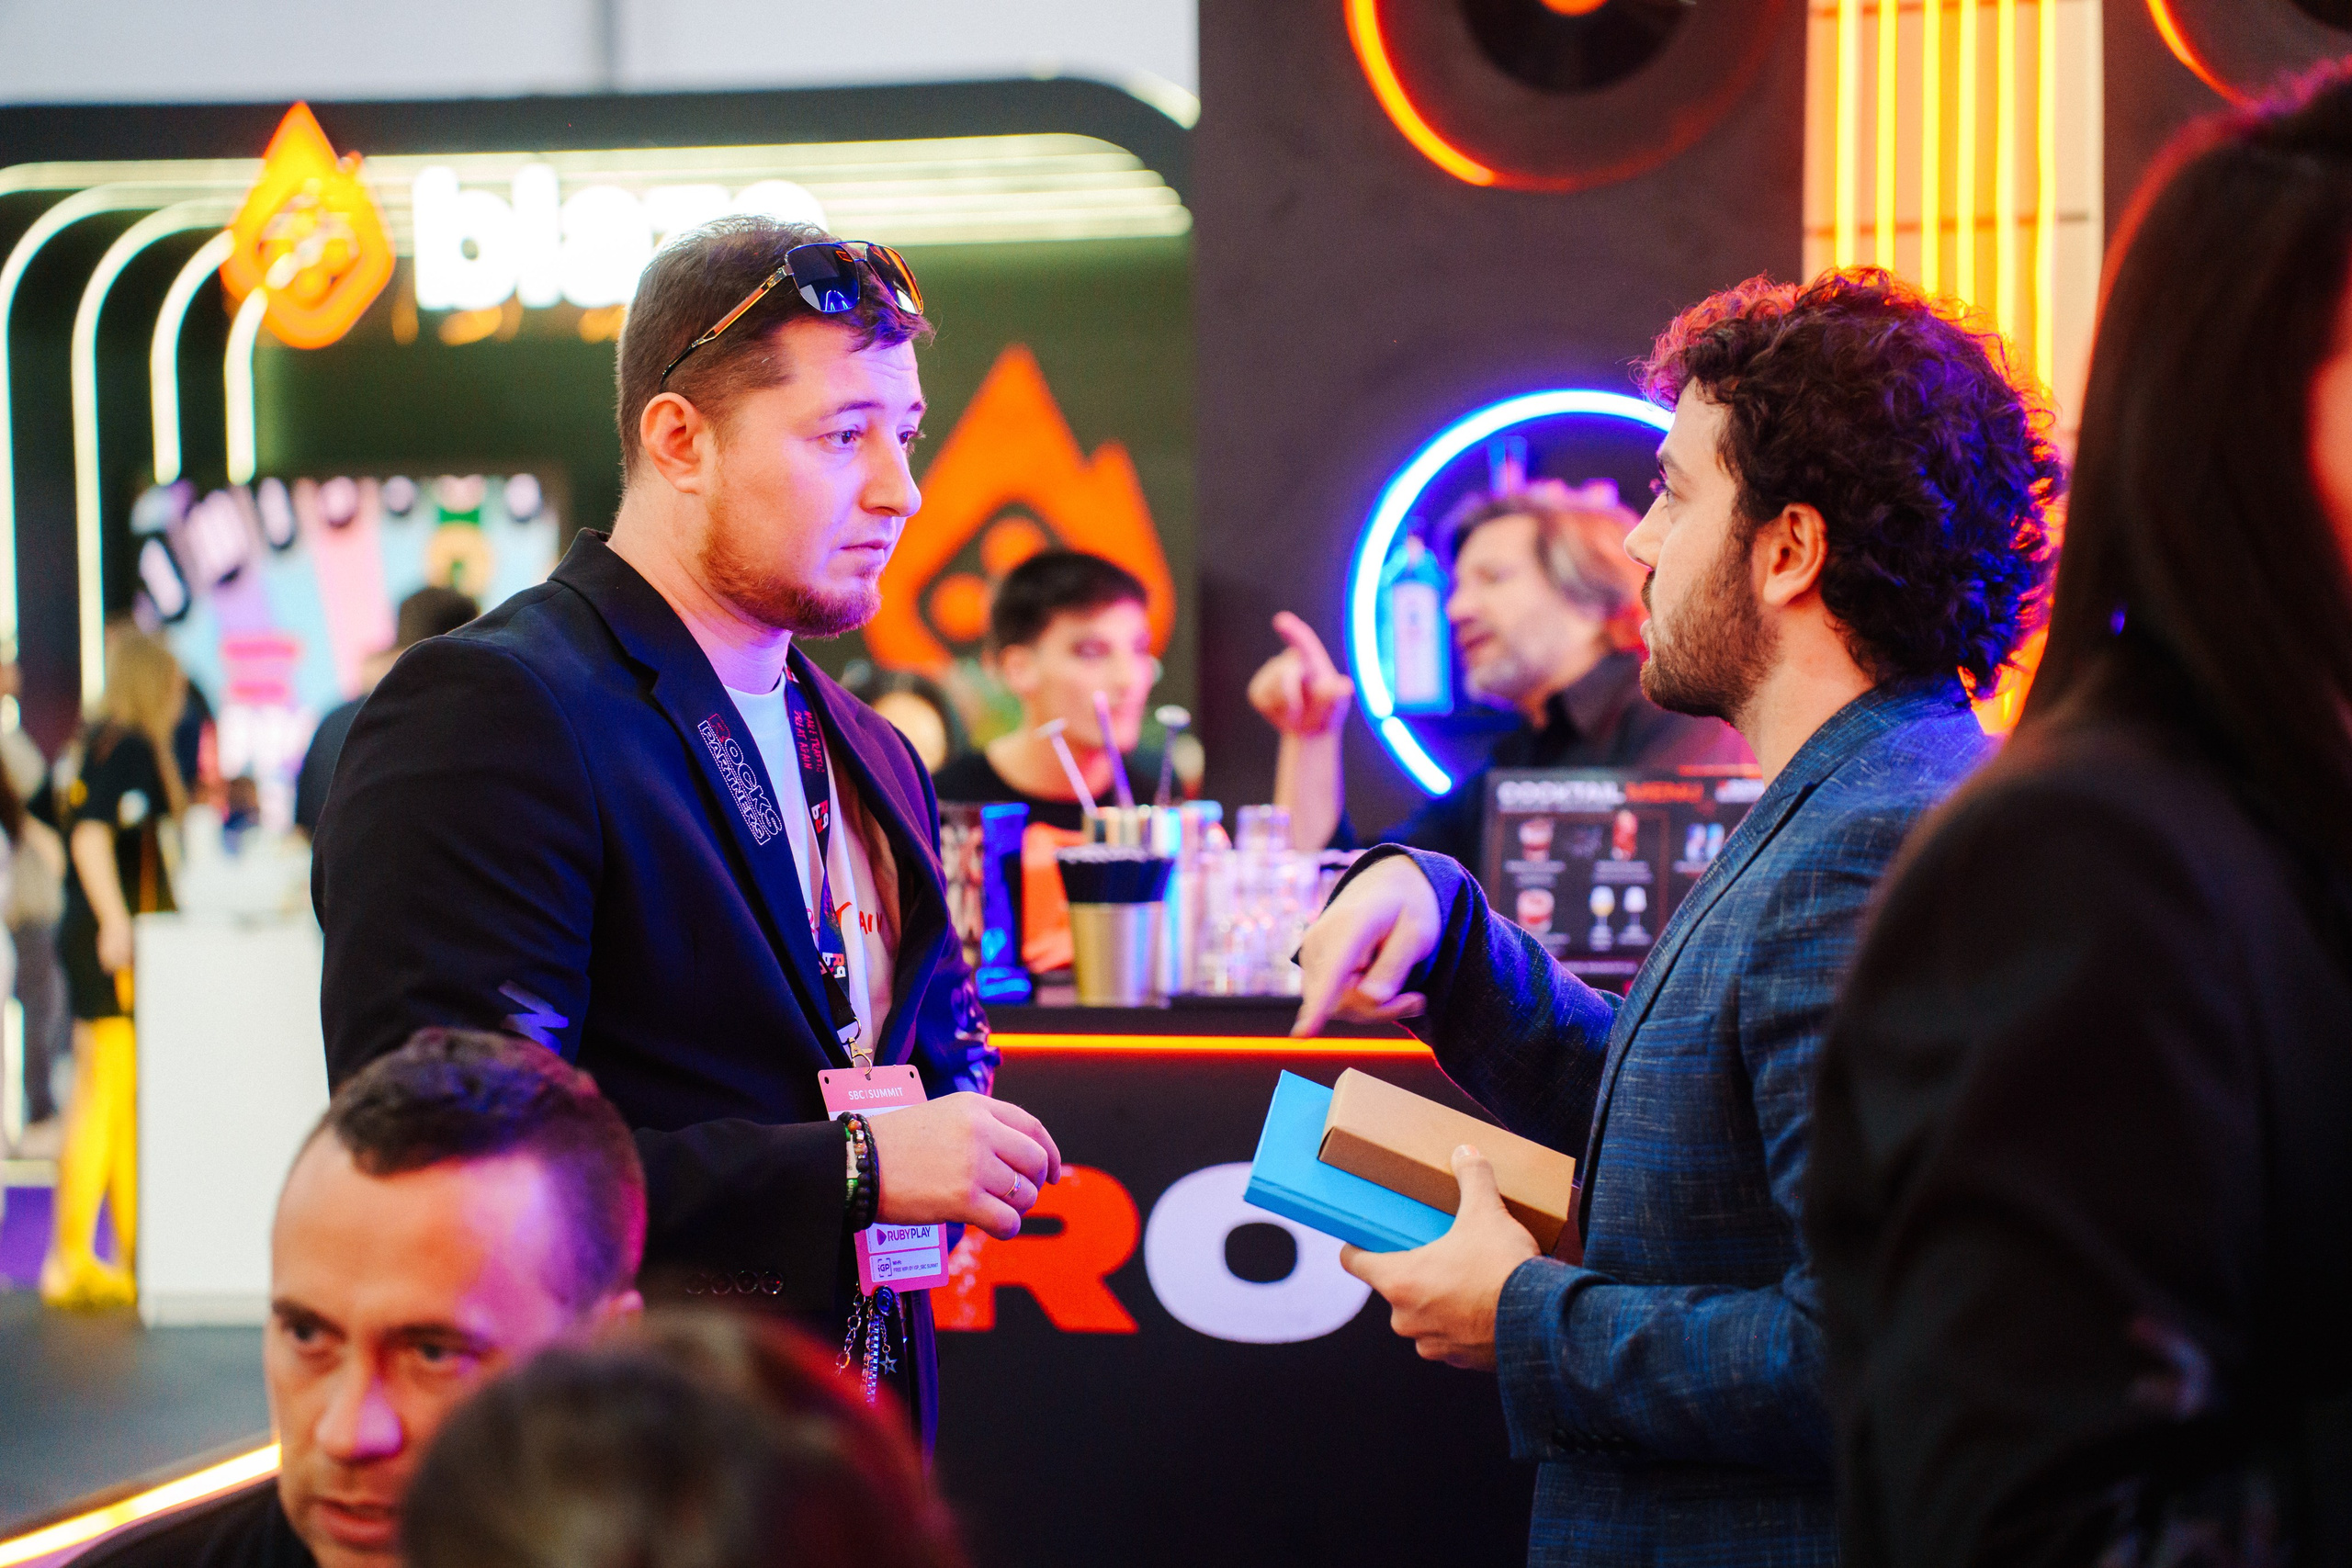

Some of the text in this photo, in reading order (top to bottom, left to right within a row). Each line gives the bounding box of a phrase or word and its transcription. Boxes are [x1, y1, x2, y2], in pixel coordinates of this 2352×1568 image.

[797, 741, 813, 770] AGAIN
[804, 710, 825, 773] MAKE TRAFFIC
[701, 723, 766, 840] PARTNERS
[707, 712, 783, 836] ROCKS
[848, 1087, 903, 1100] SBC SUMMIT
[887, 1226, 931, 1241] RUBYPLAY
